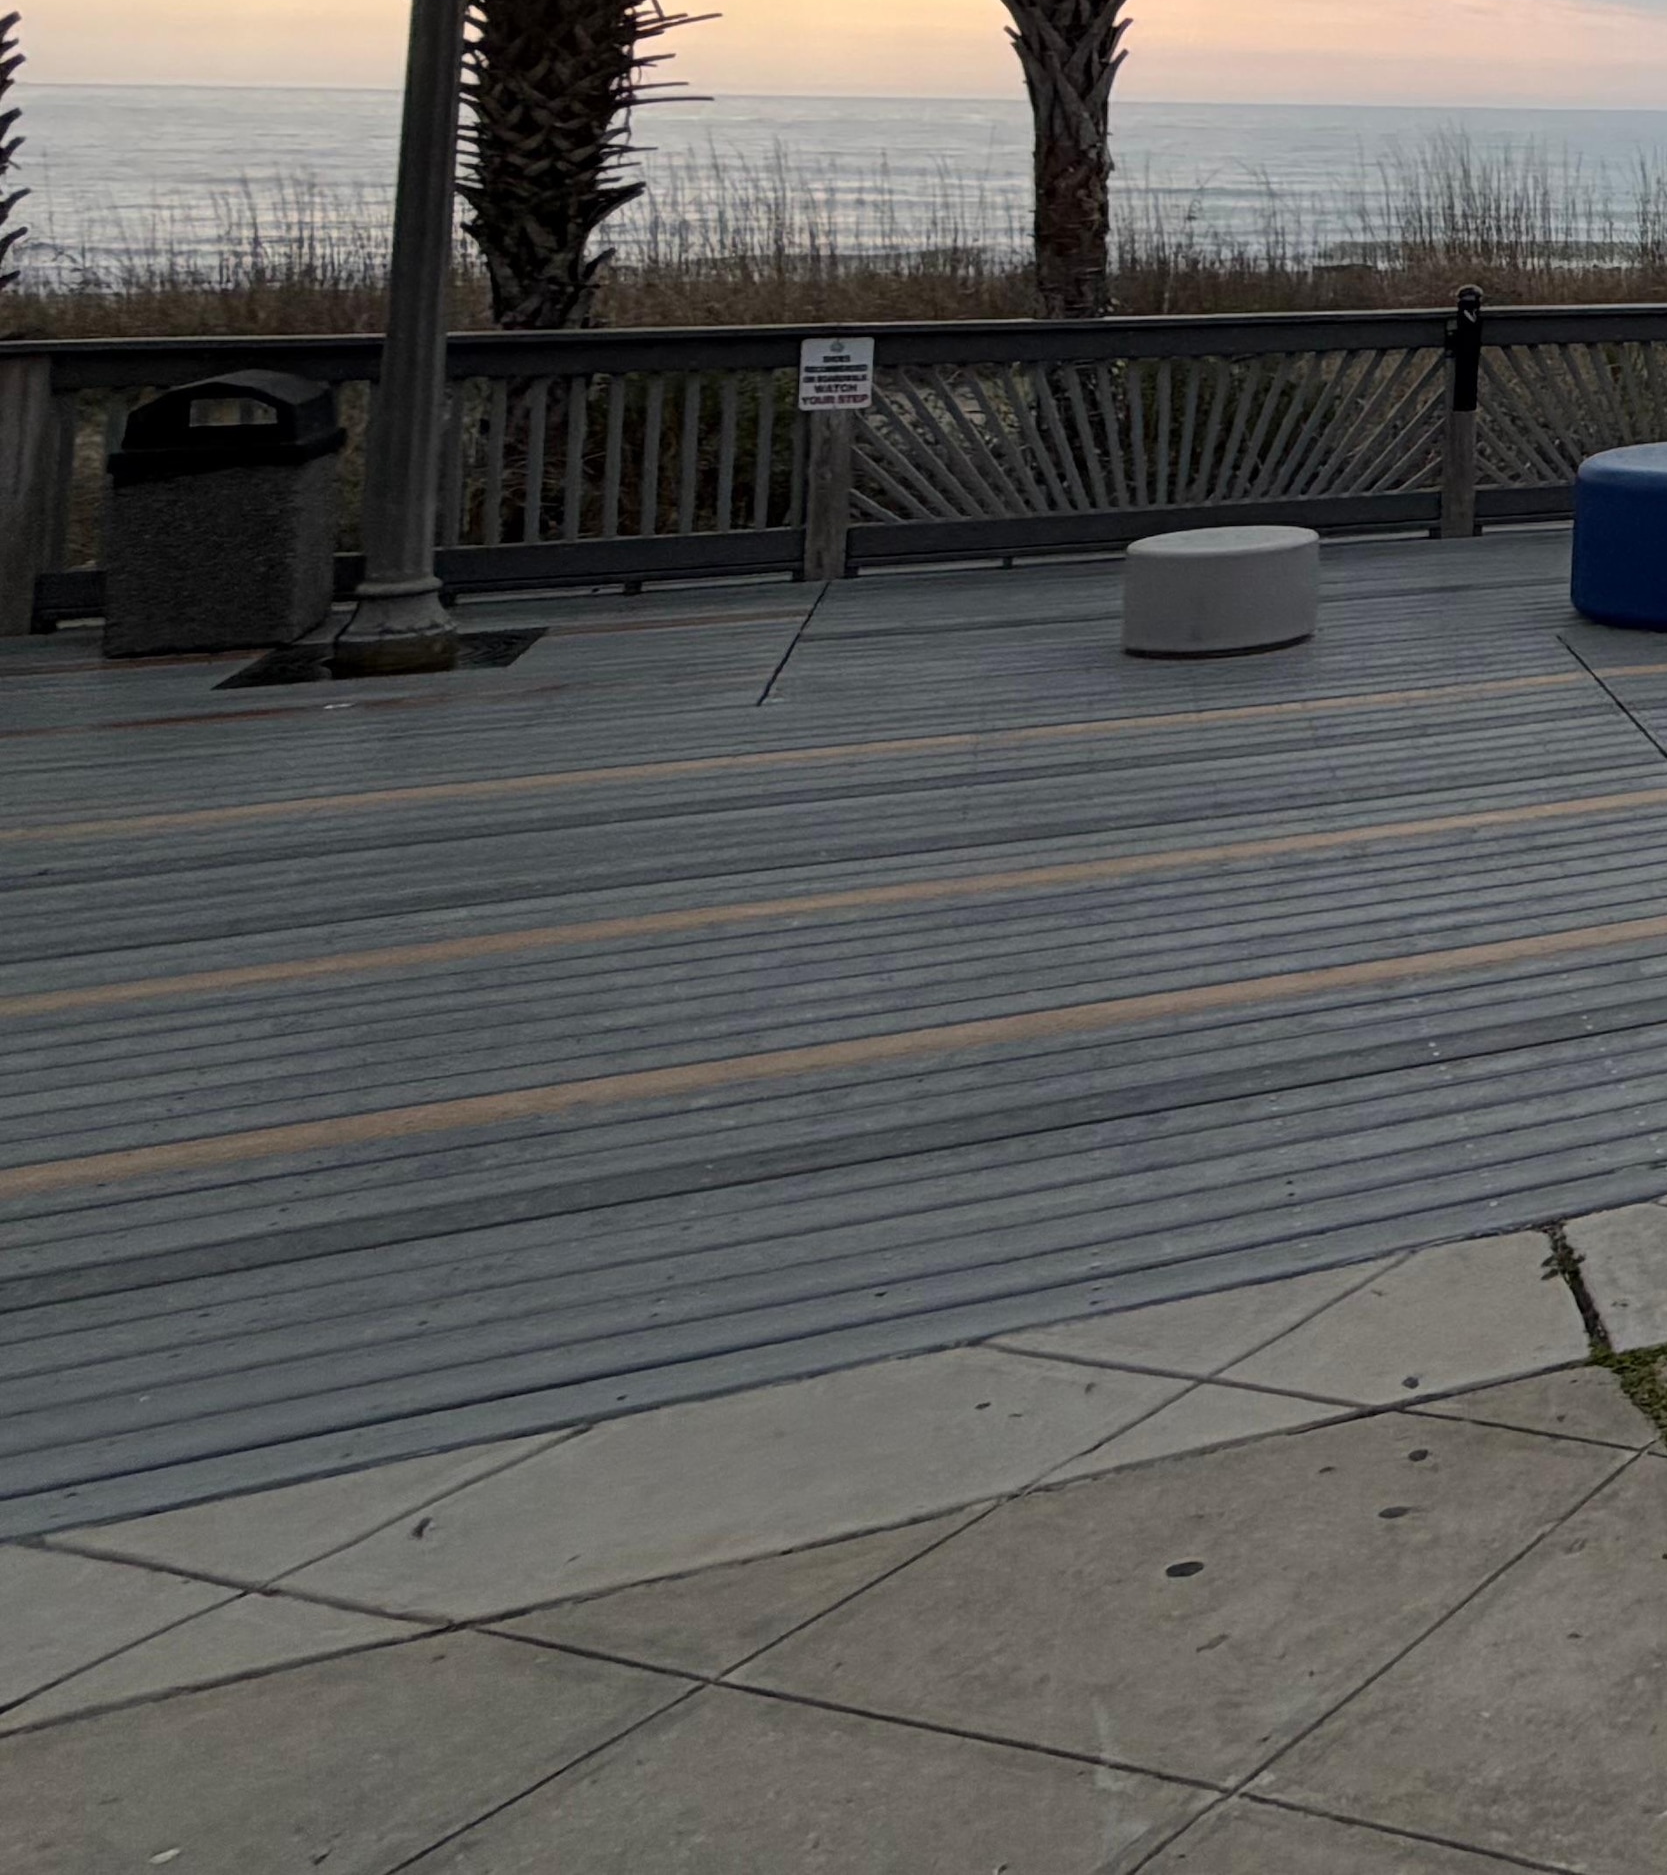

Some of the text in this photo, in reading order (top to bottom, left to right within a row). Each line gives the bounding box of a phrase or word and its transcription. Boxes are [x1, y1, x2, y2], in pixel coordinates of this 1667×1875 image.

[815, 383, 857, 393] WATCH
[802, 394, 869, 405] YOUR STEP
